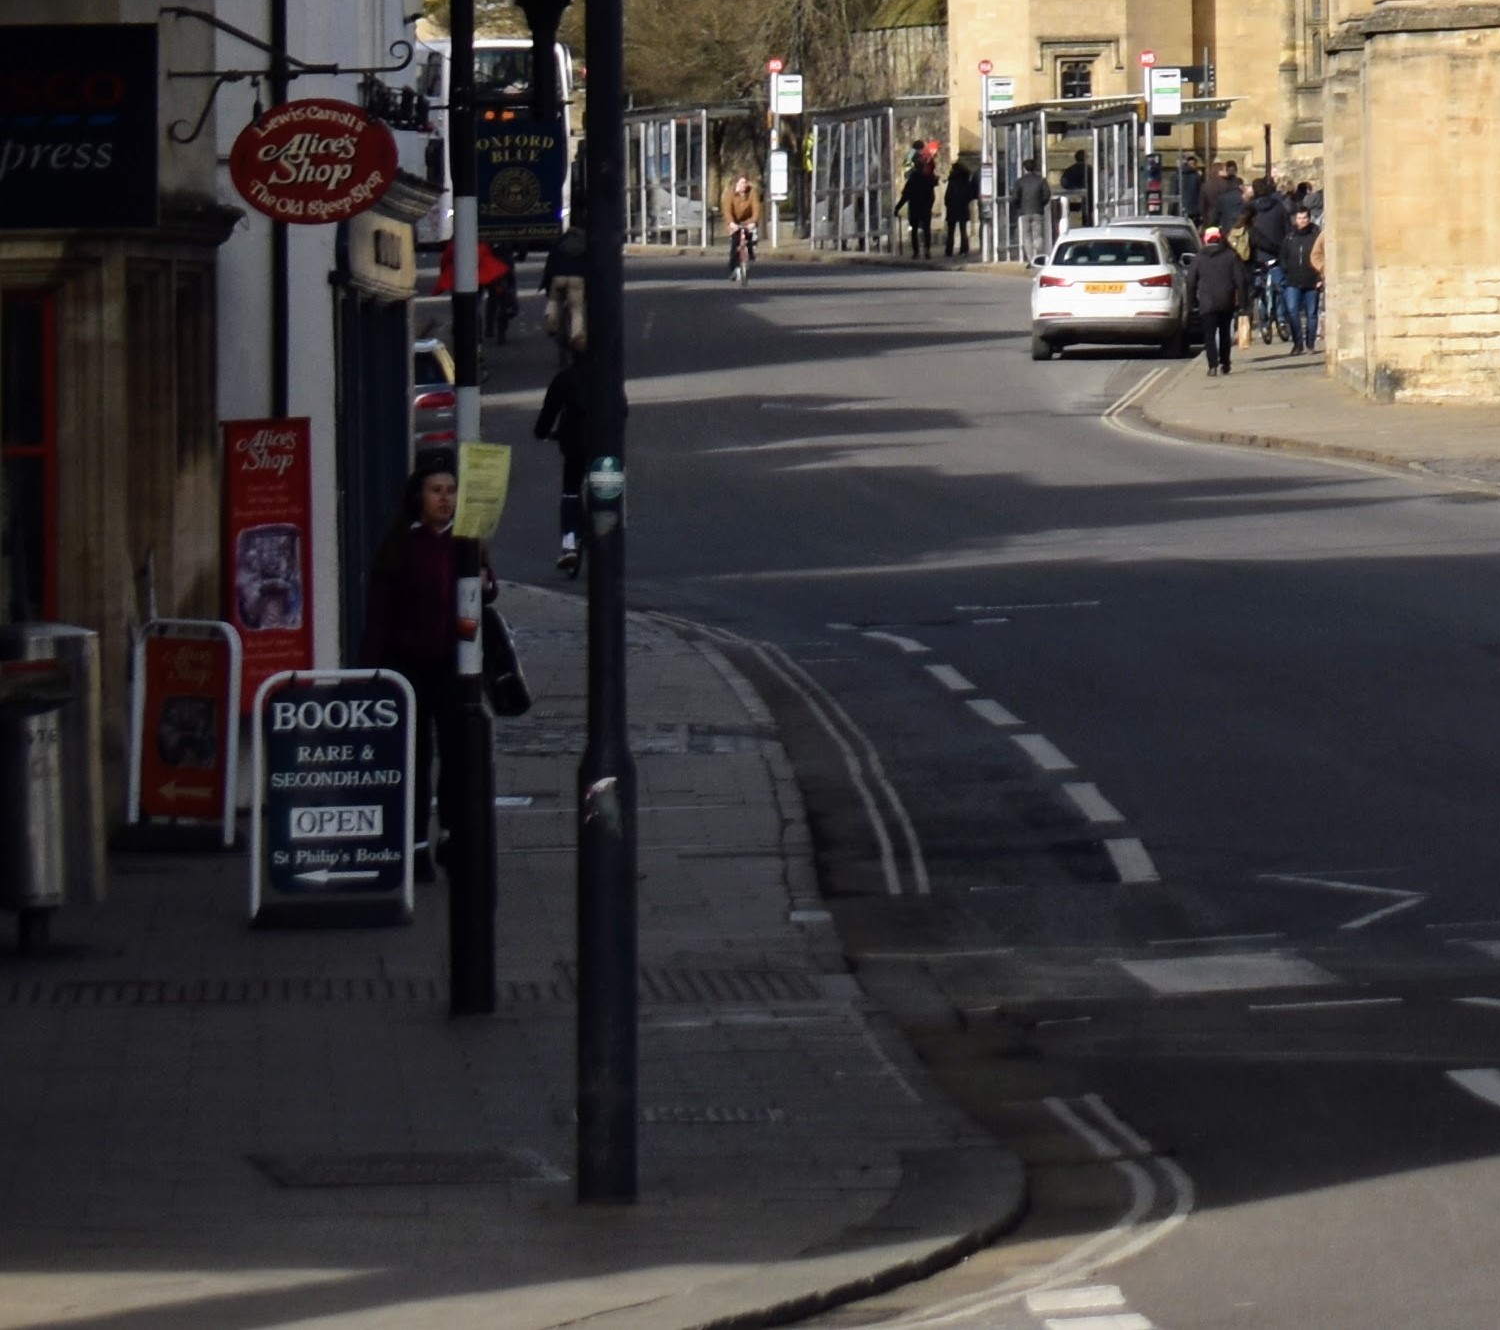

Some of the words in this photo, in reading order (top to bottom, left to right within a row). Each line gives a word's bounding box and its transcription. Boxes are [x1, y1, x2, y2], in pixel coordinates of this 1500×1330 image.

[255, 107, 306, 138] Lewis
[257, 132, 359, 164] Alice's
[474, 134, 556, 152] OXFORD
[489, 149, 542, 164] BLUE
[267, 153, 353, 191] Shop
[250, 179, 276, 207] The
[275, 197, 304, 216] Old
[350, 170, 384, 203] Shop
[235, 429, 297, 456] Alice's
[241, 449, 294, 476] Shop
[272, 699, 400, 731] BOOKS
[297, 745, 354, 763] RARE
[360, 744, 375, 761] &
[271, 769, 402, 788] SECONDHAND
[297, 808, 376, 834] OPEN
[273, 850, 290, 865] St
[295, 848, 351, 866] Philip's
[356, 847, 401, 863] Books
